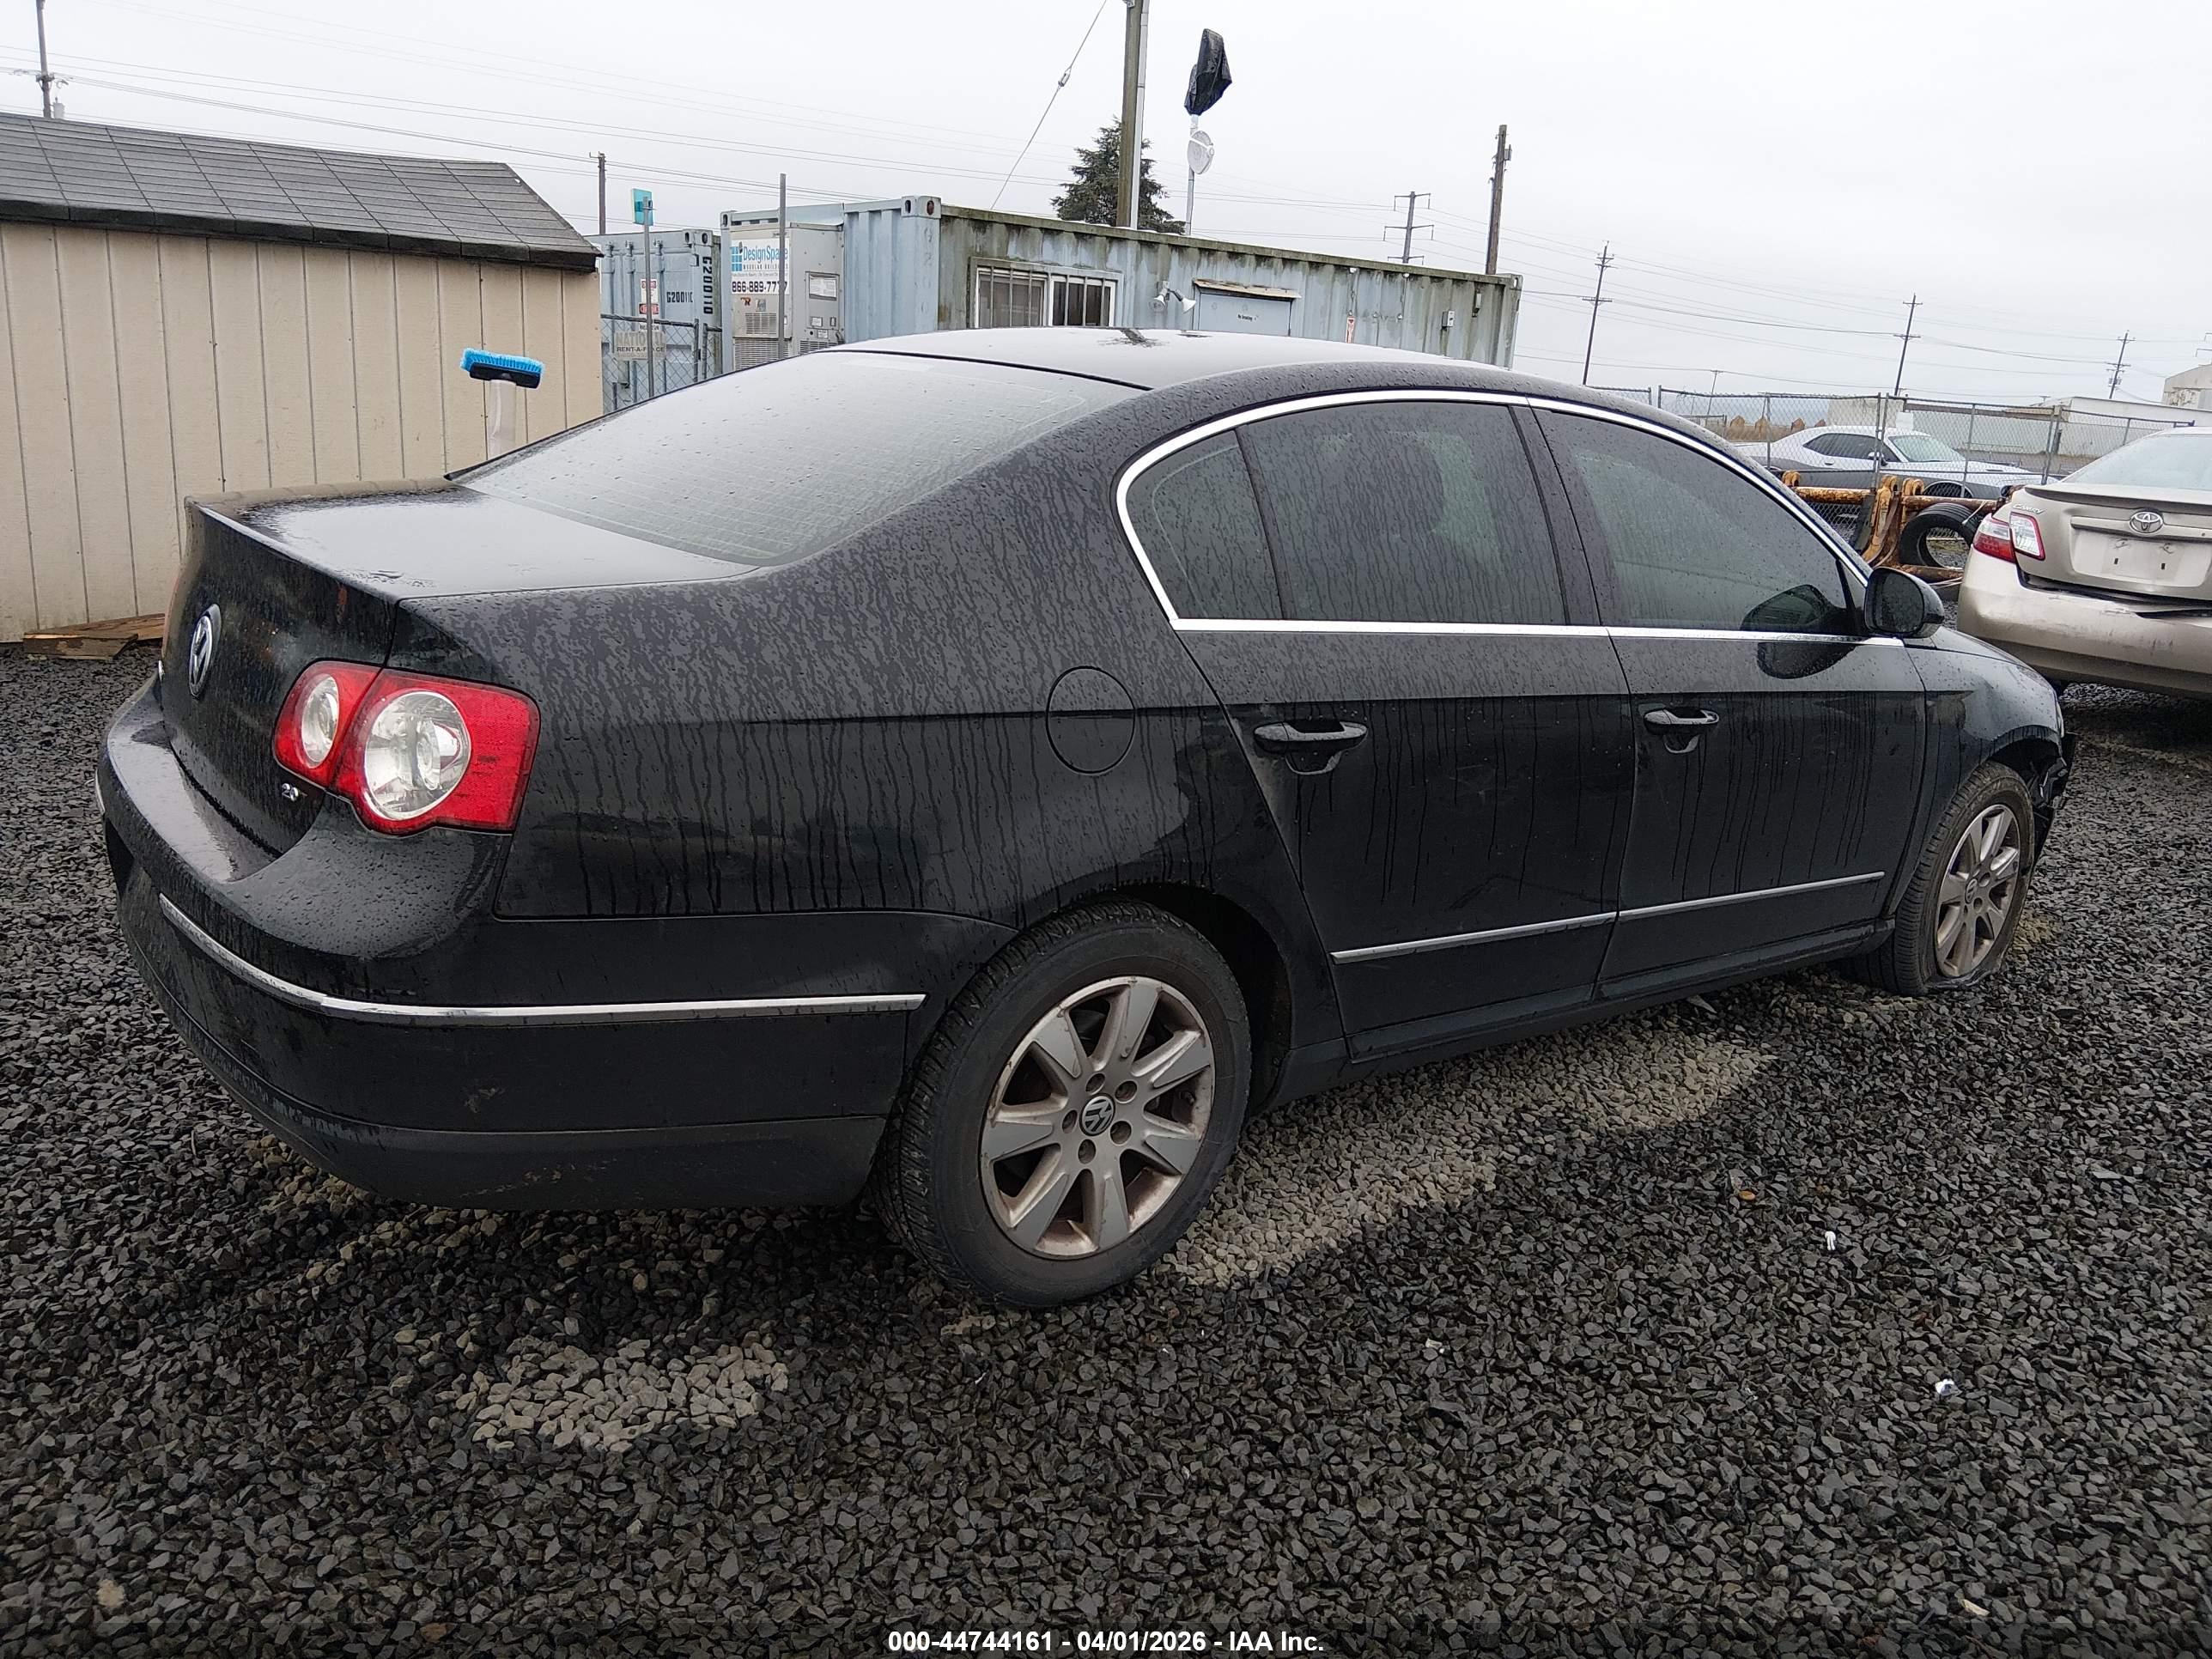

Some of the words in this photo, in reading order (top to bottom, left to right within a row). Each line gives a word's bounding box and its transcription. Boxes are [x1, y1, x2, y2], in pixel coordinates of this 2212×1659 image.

[743, 245, 788, 264] DesignSpae
[702, 256, 714, 315] G200110
[616, 332, 665, 346] NATIOAL
